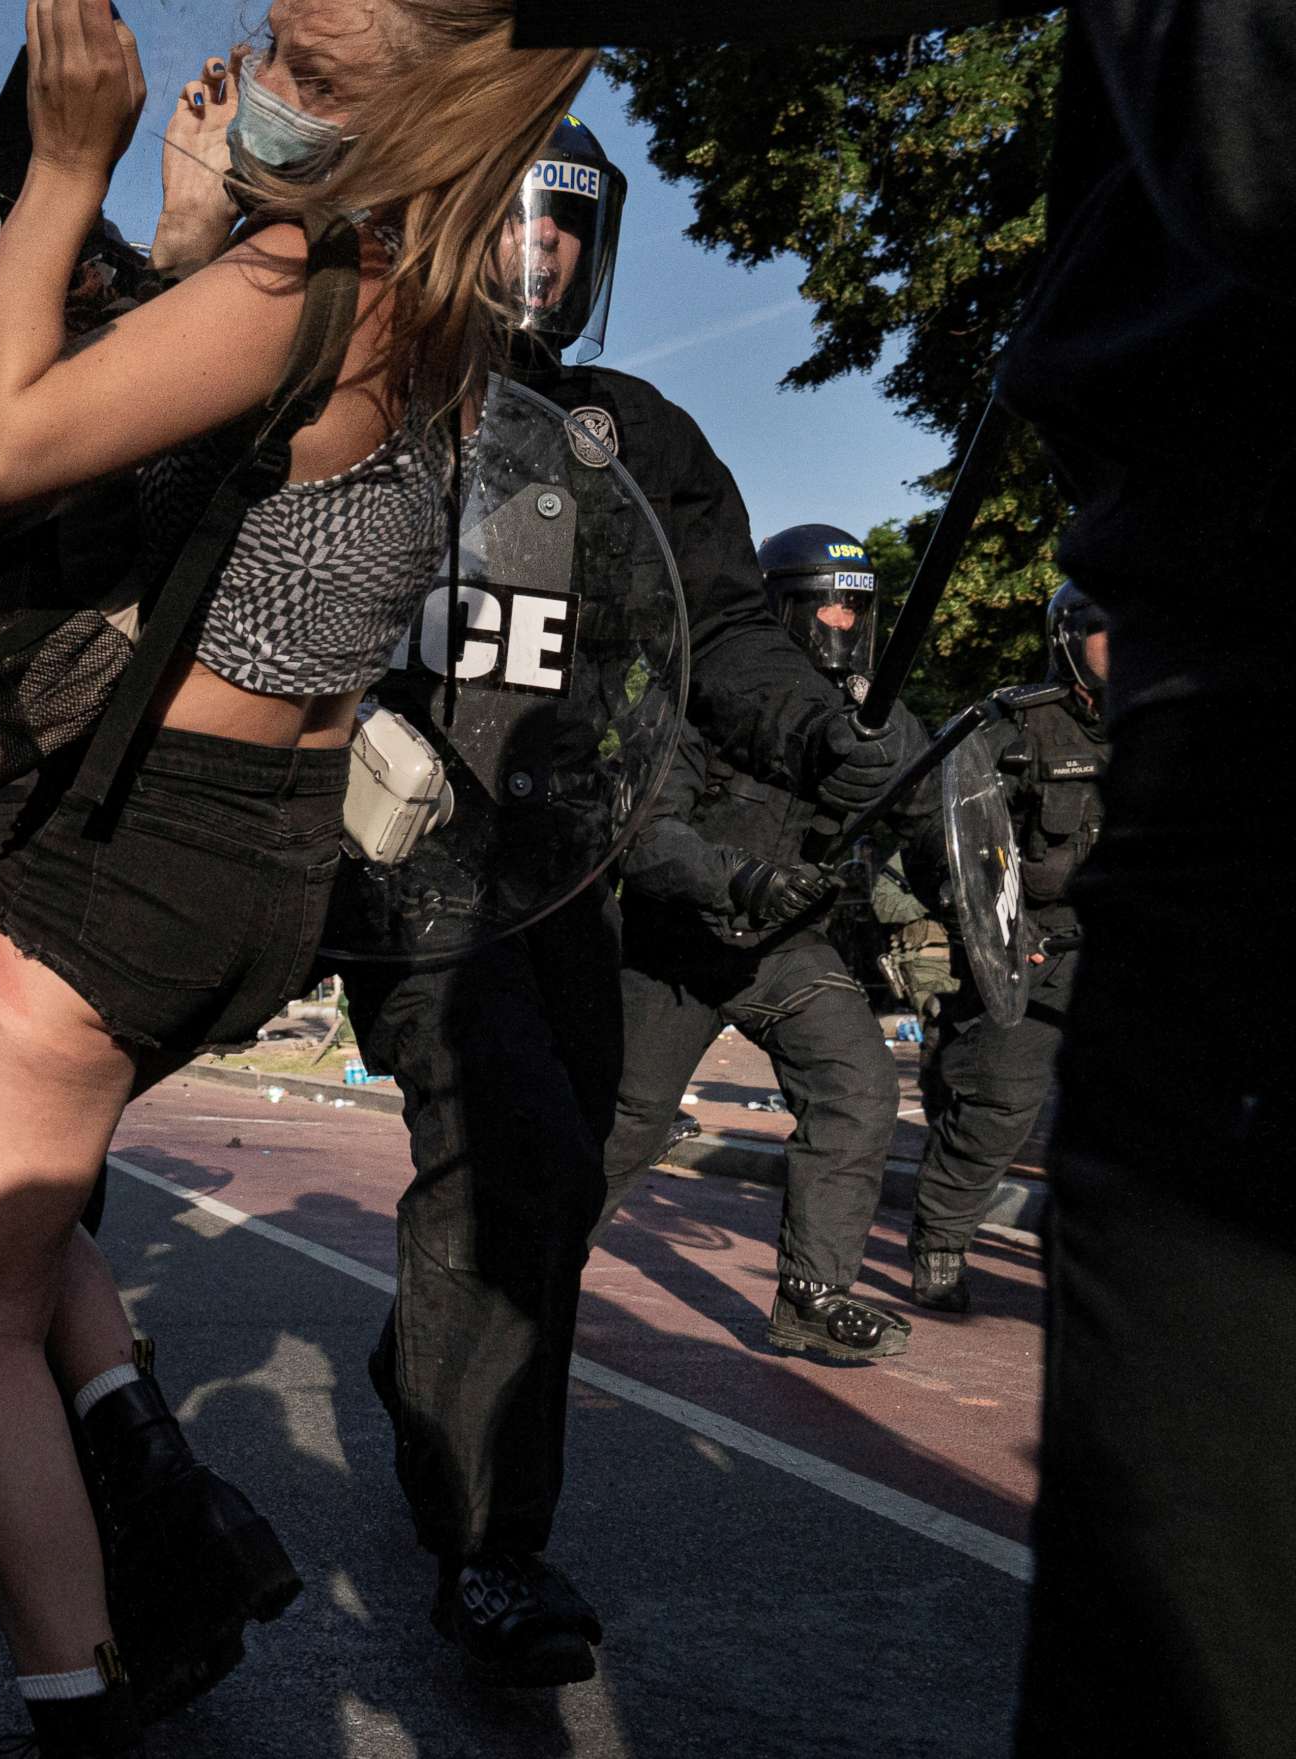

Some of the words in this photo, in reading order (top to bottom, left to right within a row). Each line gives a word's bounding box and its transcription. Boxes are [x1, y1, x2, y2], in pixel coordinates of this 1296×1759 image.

[829, 544, 865, 558] USPP
[838, 573, 874, 589] POLICE
[387, 585, 568, 690] CE
[1072, 765, 1095, 774] POLICE
